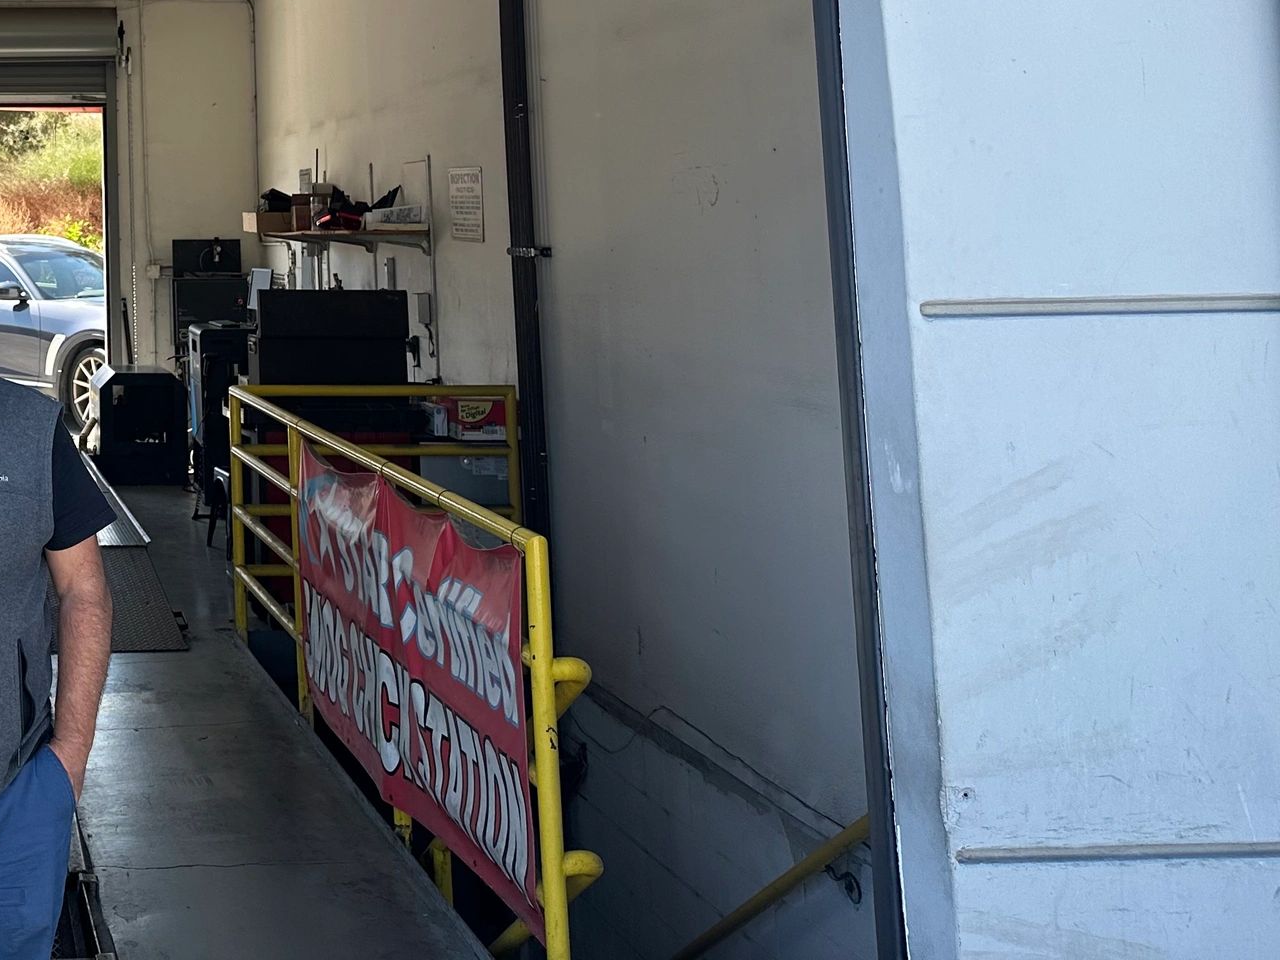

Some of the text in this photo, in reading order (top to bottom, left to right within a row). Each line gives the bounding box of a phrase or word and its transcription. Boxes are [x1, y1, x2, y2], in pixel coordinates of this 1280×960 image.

[465, 408, 486, 420] Digital
[349, 620, 425, 789] CHCK
[409, 677, 535, 909] STATION
